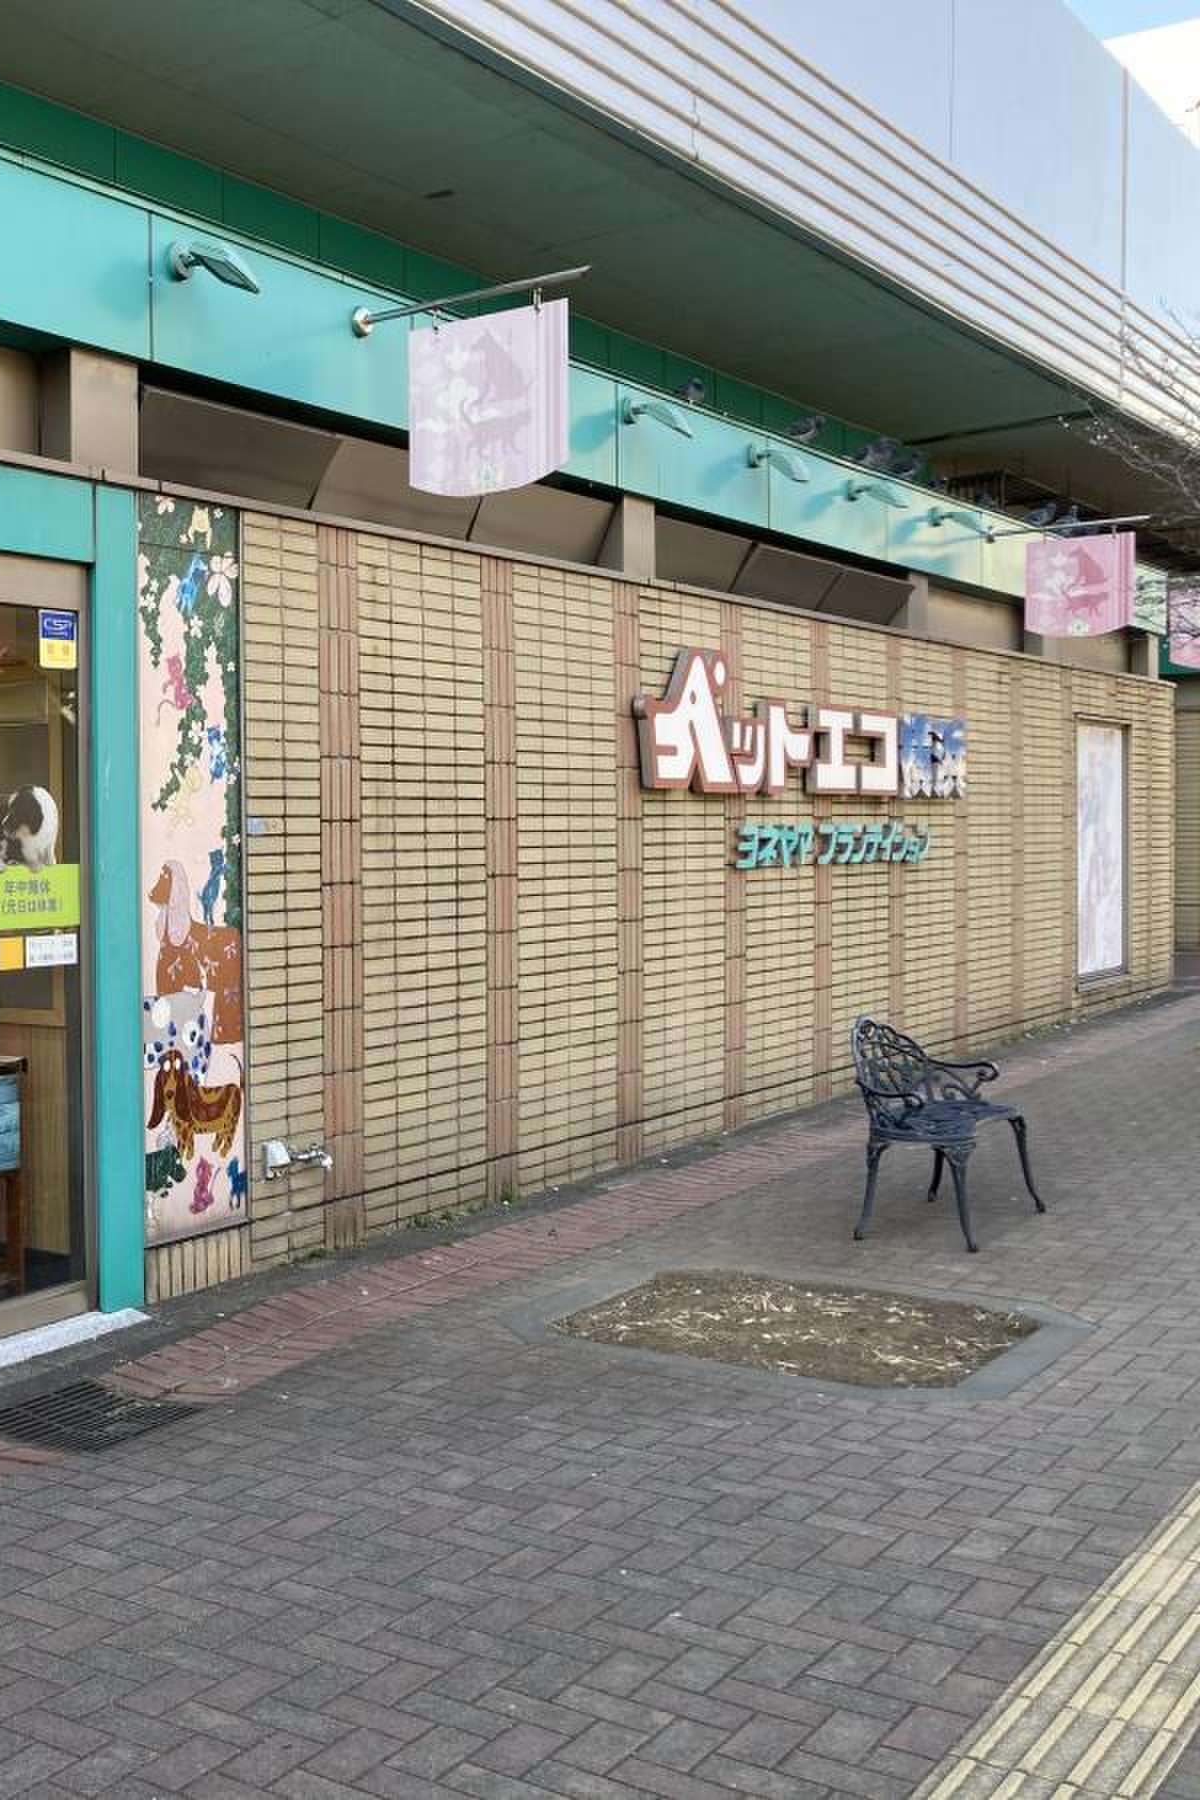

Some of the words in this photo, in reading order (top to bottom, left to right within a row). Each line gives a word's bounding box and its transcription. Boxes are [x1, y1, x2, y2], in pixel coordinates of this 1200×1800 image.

[646, 650, 899, 794] ペットエコ
